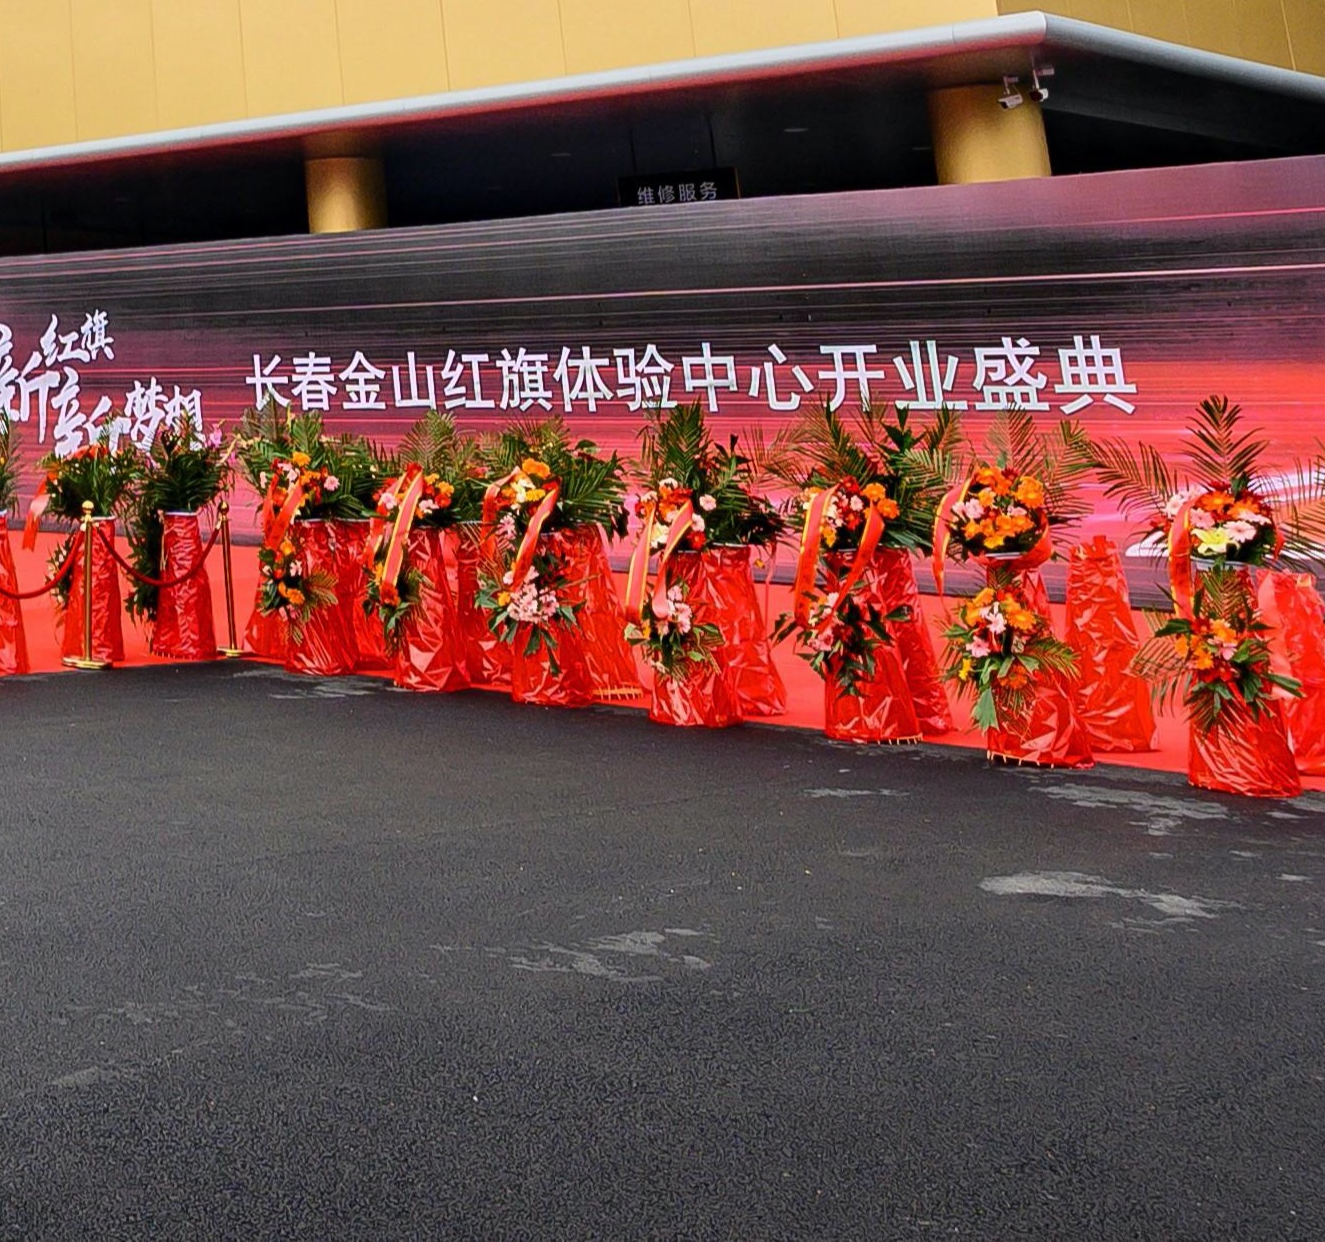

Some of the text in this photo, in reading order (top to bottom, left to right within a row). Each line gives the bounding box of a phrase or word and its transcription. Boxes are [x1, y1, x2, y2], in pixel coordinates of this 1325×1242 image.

[637, 181, 718, 205] 维修服务
[245, 334, 1137, 412] 长春金山红旗体验中心开业盛典
